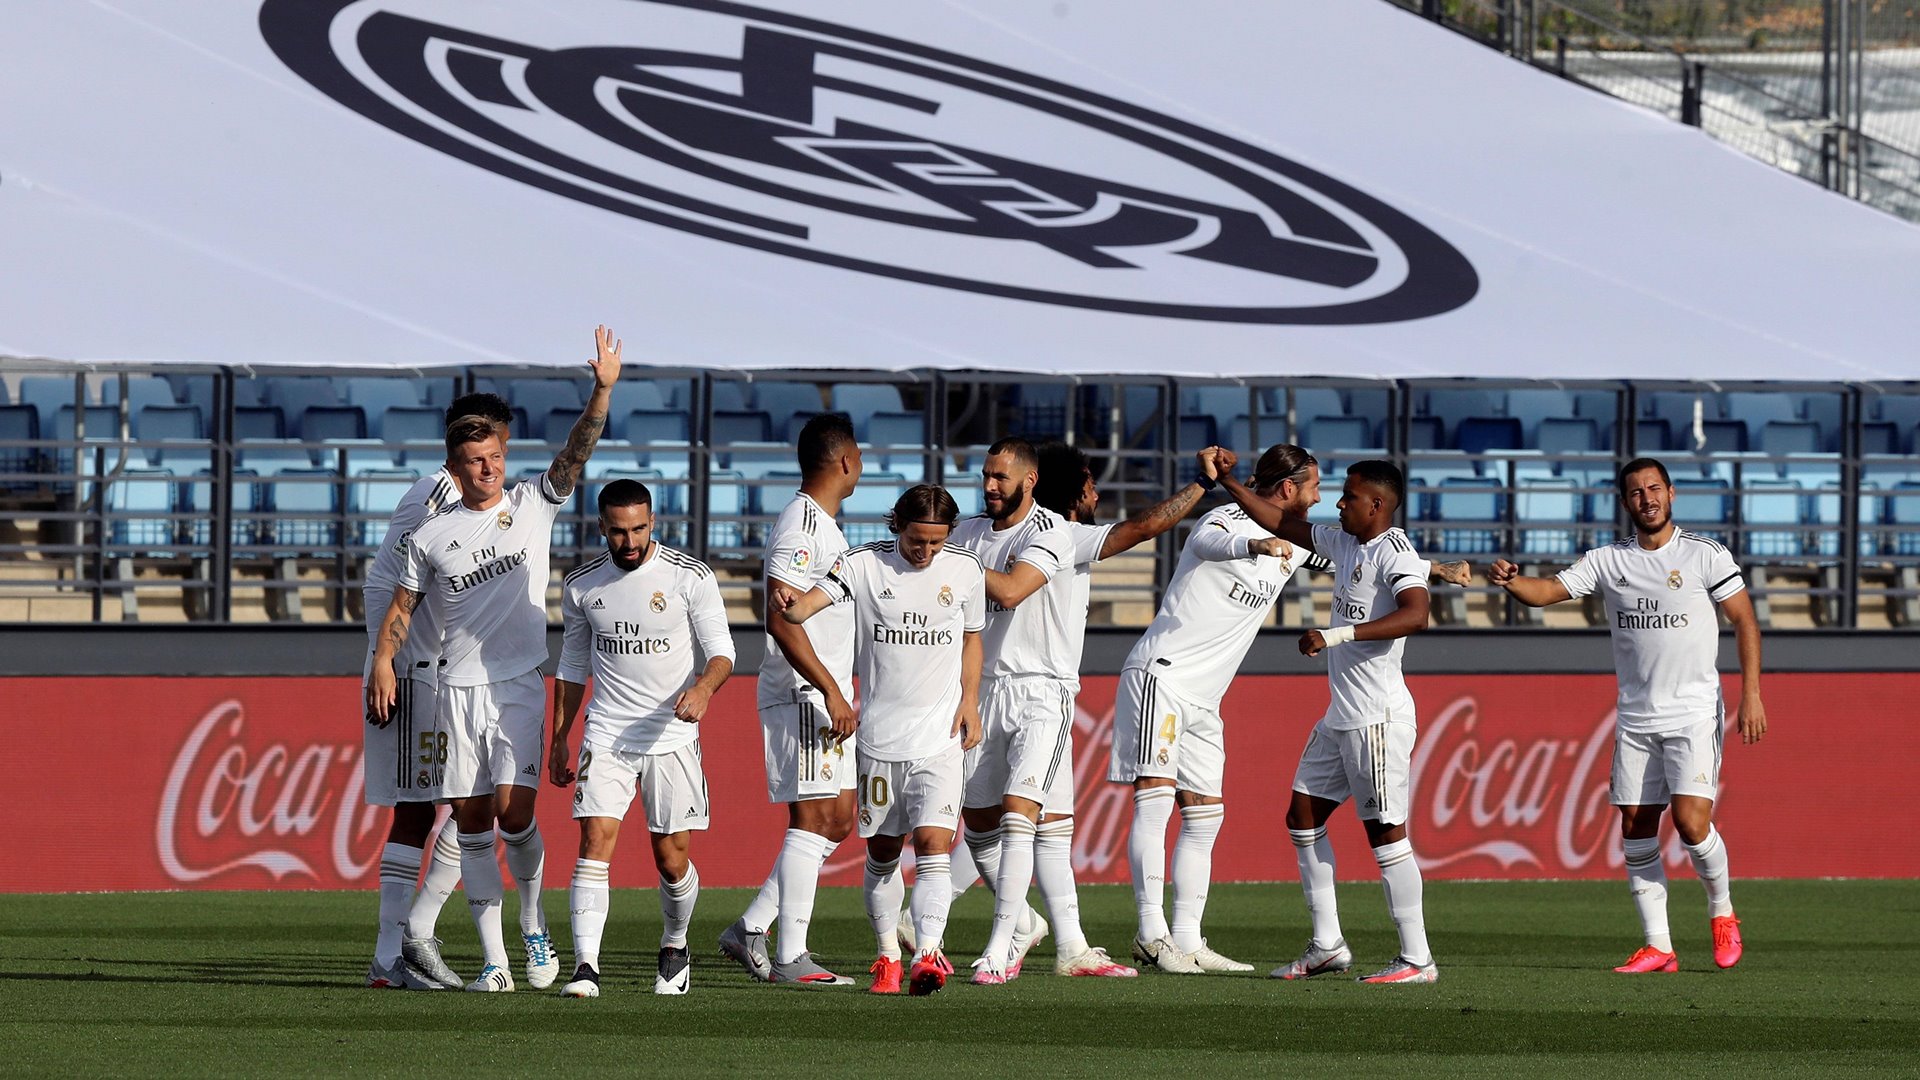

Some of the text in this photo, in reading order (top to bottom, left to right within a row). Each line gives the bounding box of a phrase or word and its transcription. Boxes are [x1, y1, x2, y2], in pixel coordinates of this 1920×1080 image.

[471, 545, 497, 563] Fly
[448, 547, 527, 593] Emirates
[1228, 581, 1268, 609] Emir
[1258, 580, 1276, 596] Fly
[1637, 597, 1658, 612] Fly
[614, 621, 639, 637] Fly
[902, 611, 928, 628] Fly
[1616, 611, 1689, 629] Emirates
[596, 634, 671, 655] Emirates
[873, 623, 953, 646] Emirates
[1160, 714, 1177, 744] 4
[578, 750, 592, 781] 2
[858, 773, 889, 808] 10
